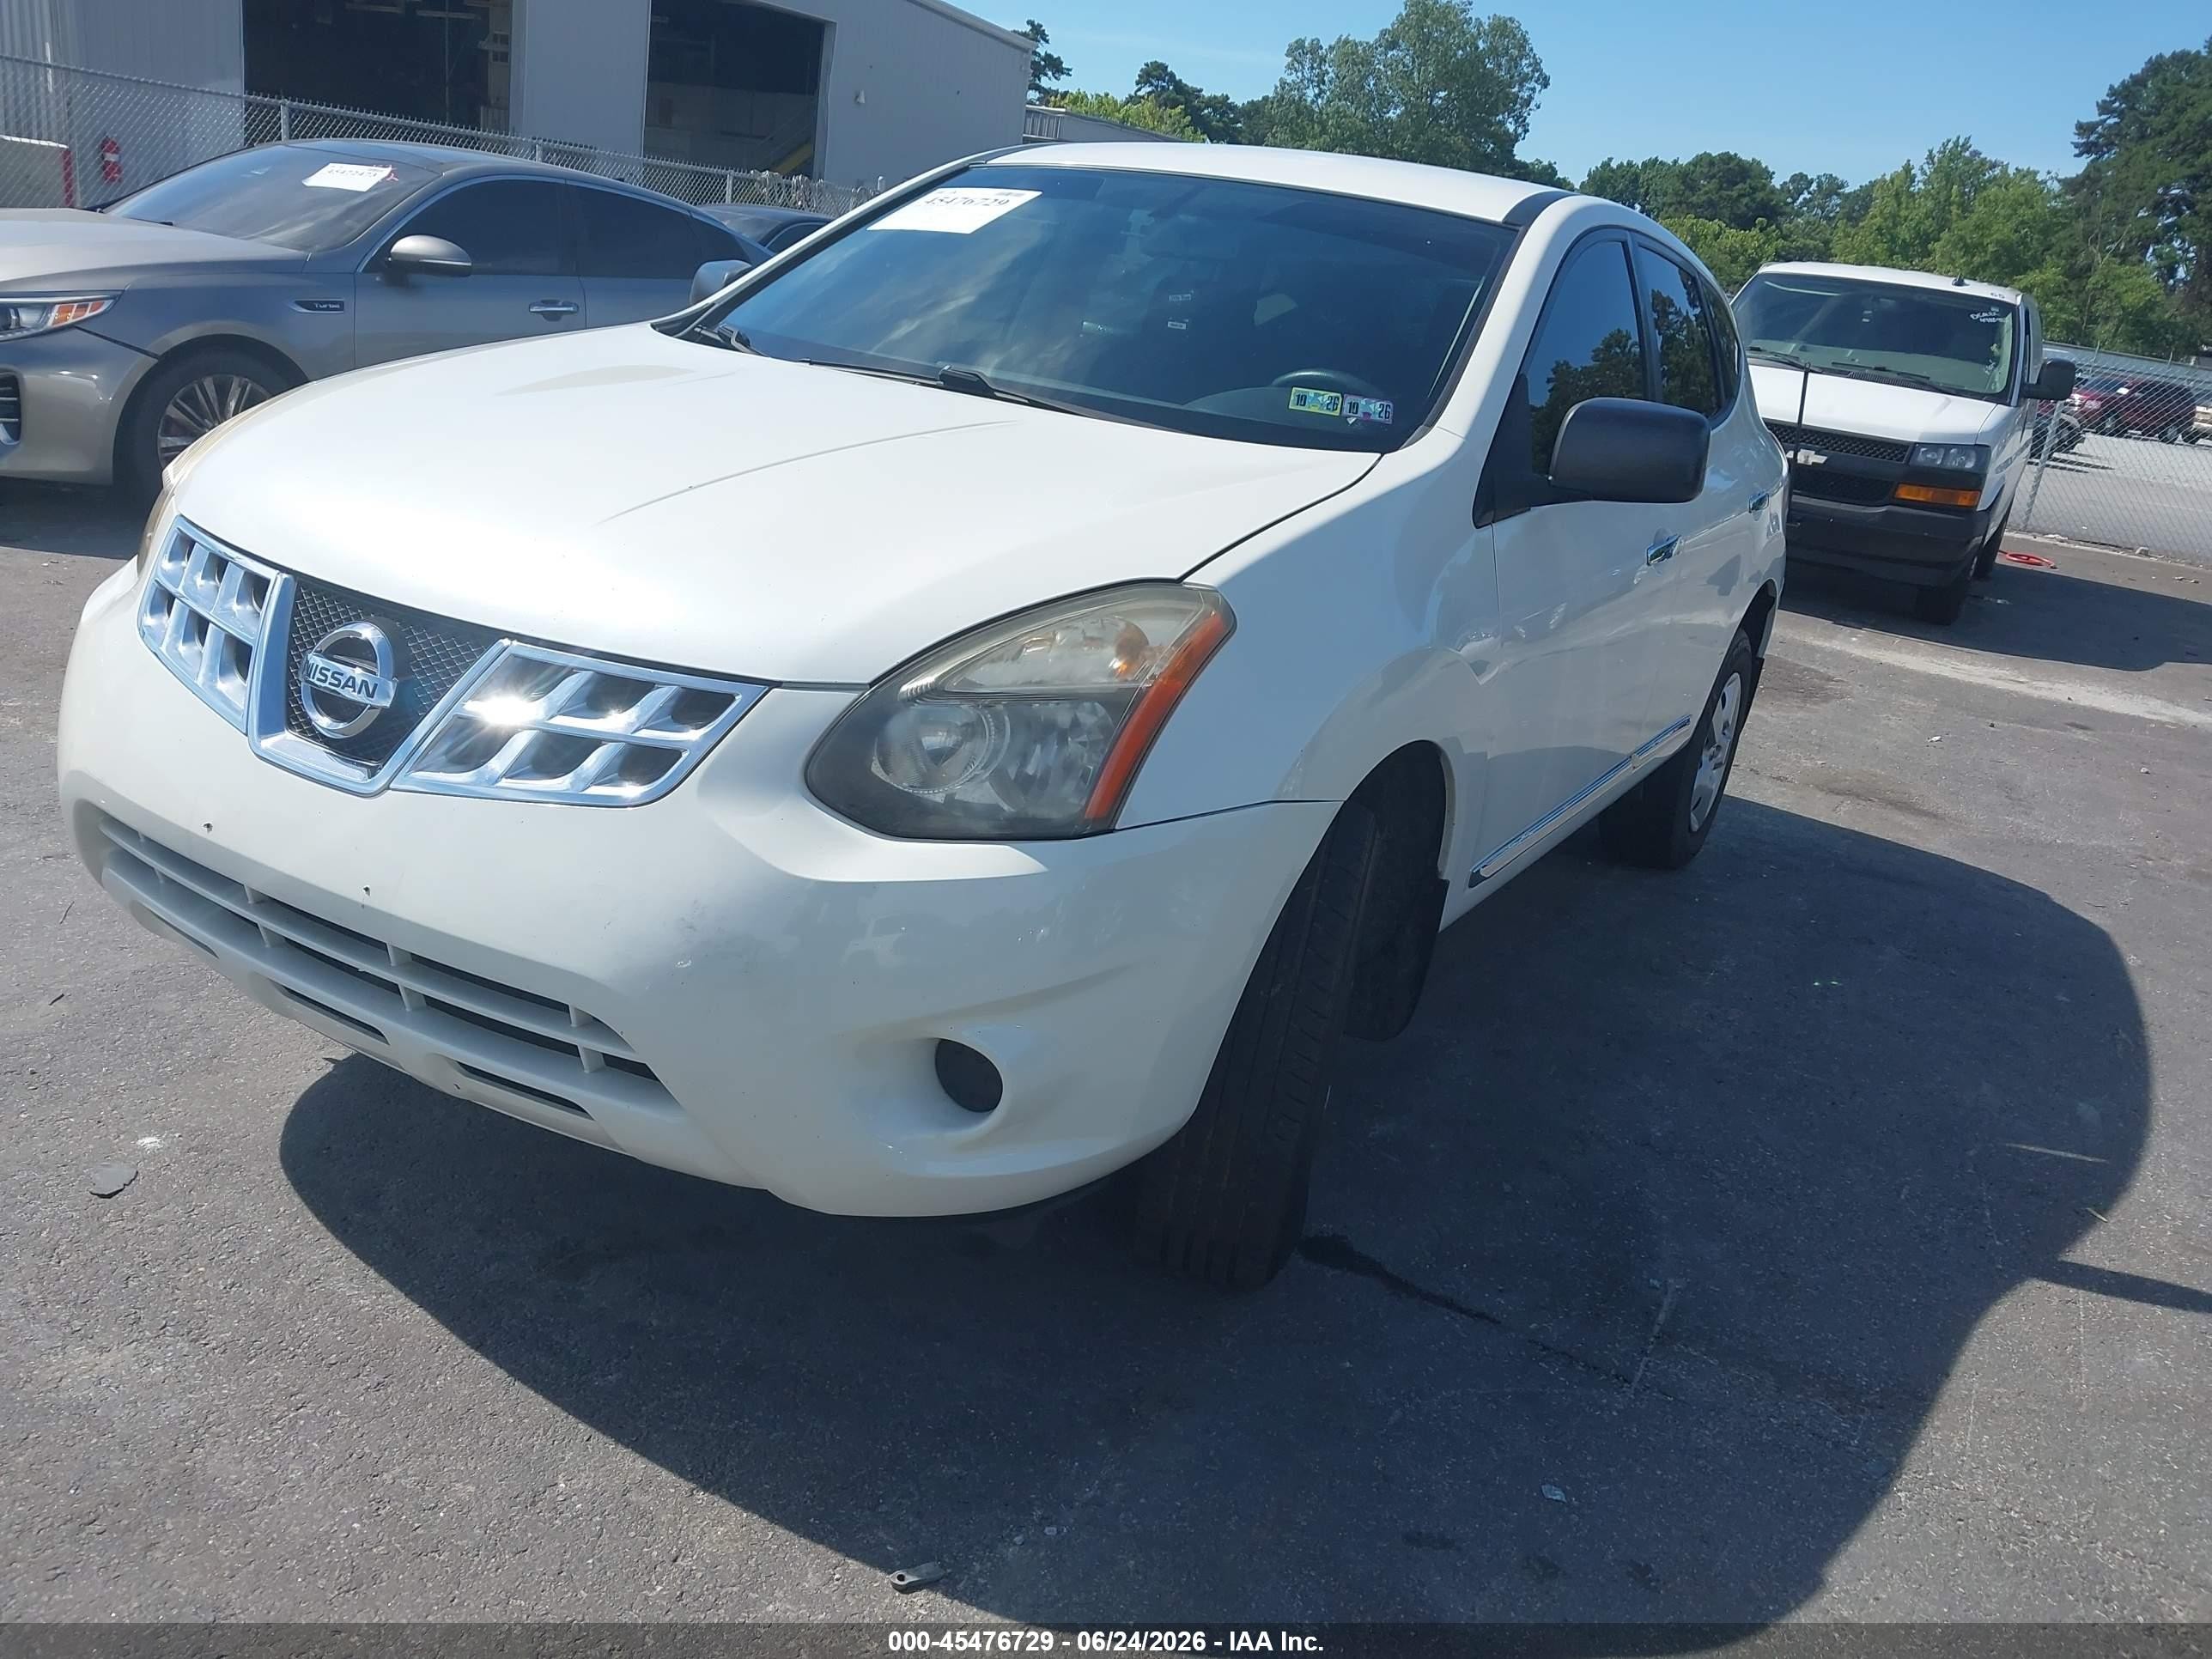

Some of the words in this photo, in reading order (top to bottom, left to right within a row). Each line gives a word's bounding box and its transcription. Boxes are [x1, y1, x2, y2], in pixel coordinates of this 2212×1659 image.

[925, 197, 1009, 205] 45476729
[1295, 393, 1307, 407] 10
[1326, 397, 1340, 411] 26
[1347, 400, 1359, 415] 10
[1378, 403, 1391, 419] 26
[305, 662, 378, 698] NISSAN
